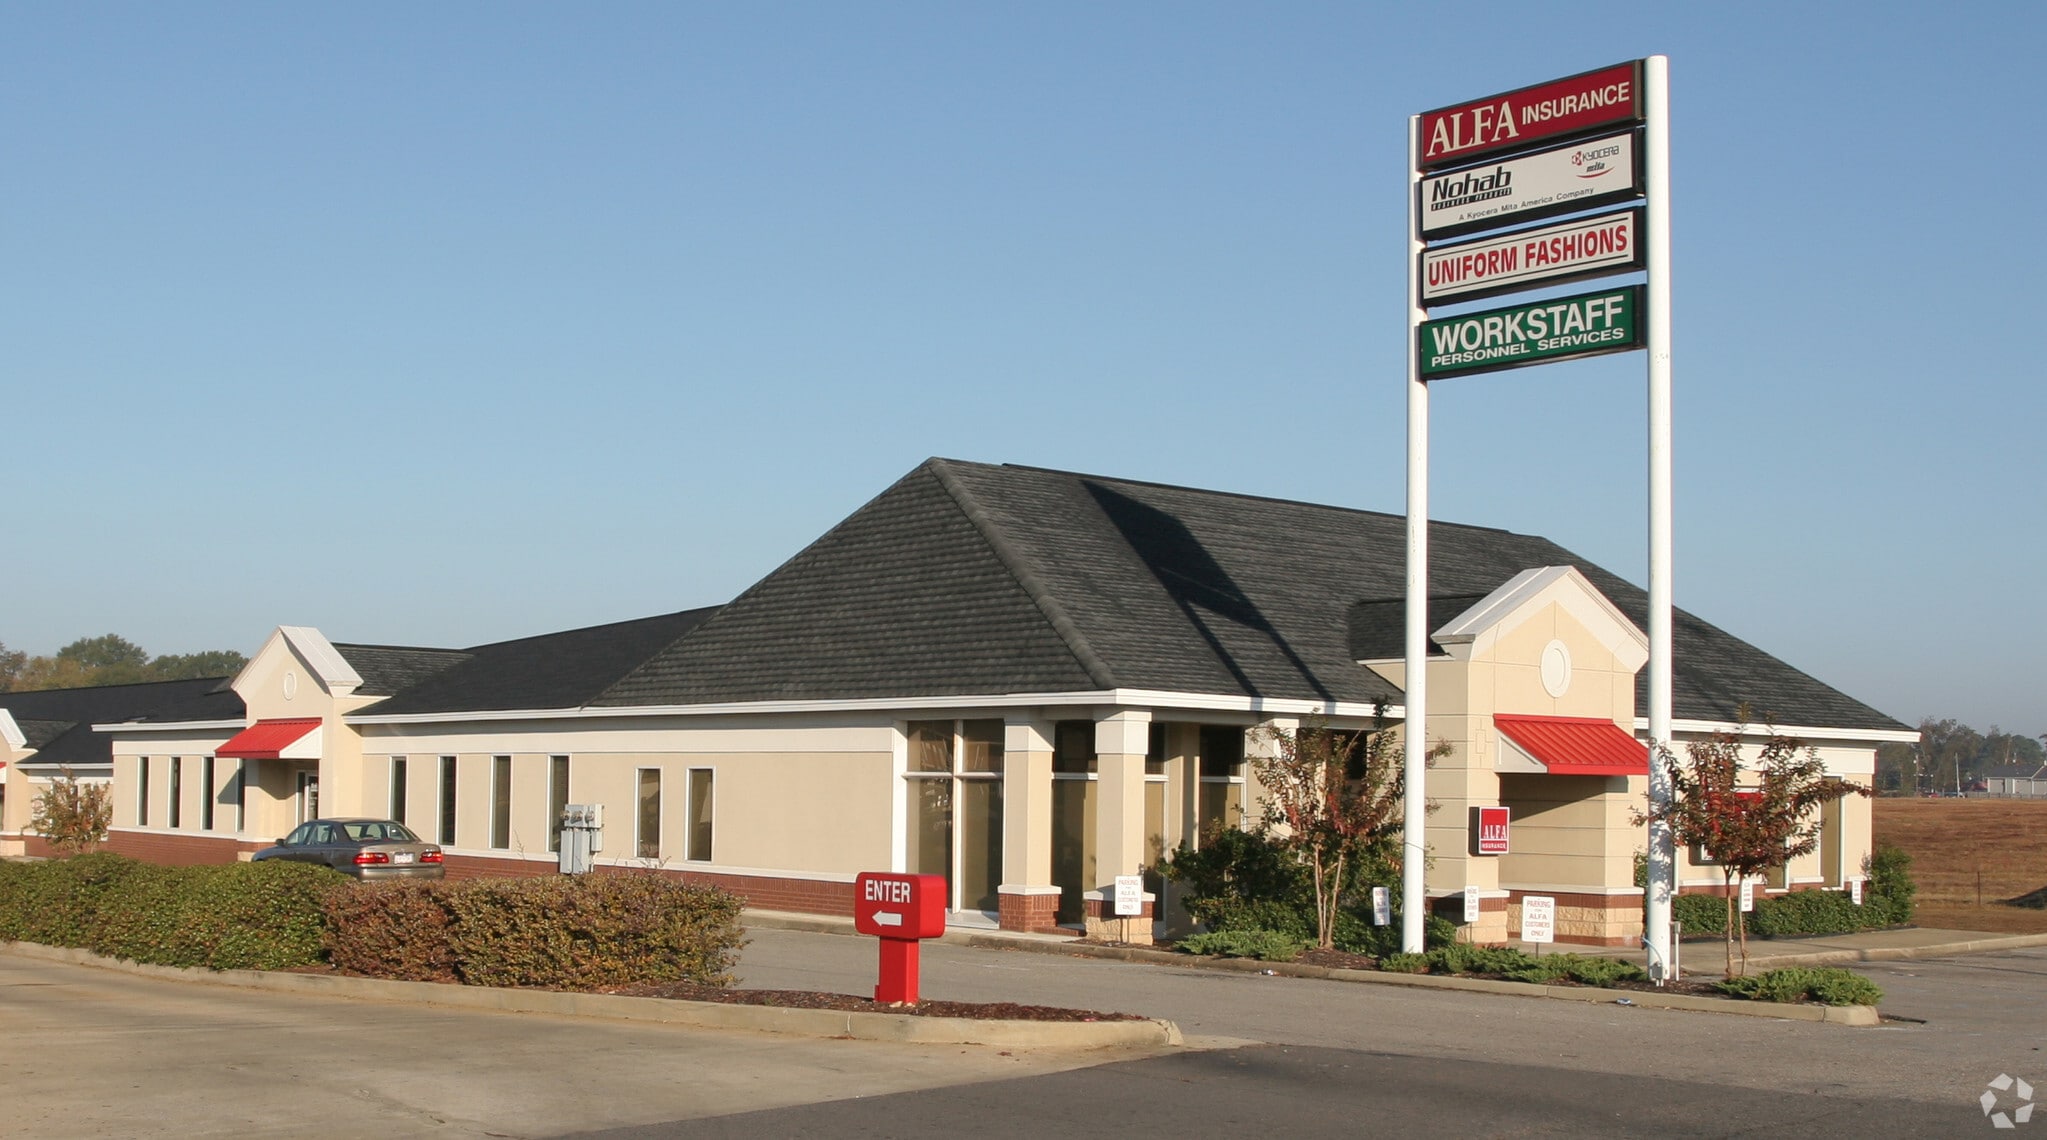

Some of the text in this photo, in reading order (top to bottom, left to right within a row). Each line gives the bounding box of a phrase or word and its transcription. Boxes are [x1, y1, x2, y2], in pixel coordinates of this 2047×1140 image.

[1426, 82, 1630, 157] ALFA INSURANCE
[1583, 145, 1619, 162] KYOCERA
[1432, 166, 1511, 202] Nohab
[1467, 208, 1498, 219] Kyocera
[1501, 204, 1518, 212] Mita
[1521, 196, 1553, 208] America
[1556, 187, 1594, 200] Company
[1428, 225, 1627, 286] UNIFORM FASHIONS
[1432, 295, 1624, 355] WORKSTAFF
[1431, 327, 1625, 367] PERSONNEL SERVICES
[1483, 824, 1507, 839] ALFA
[865, 879, 911, 904] ENTER
